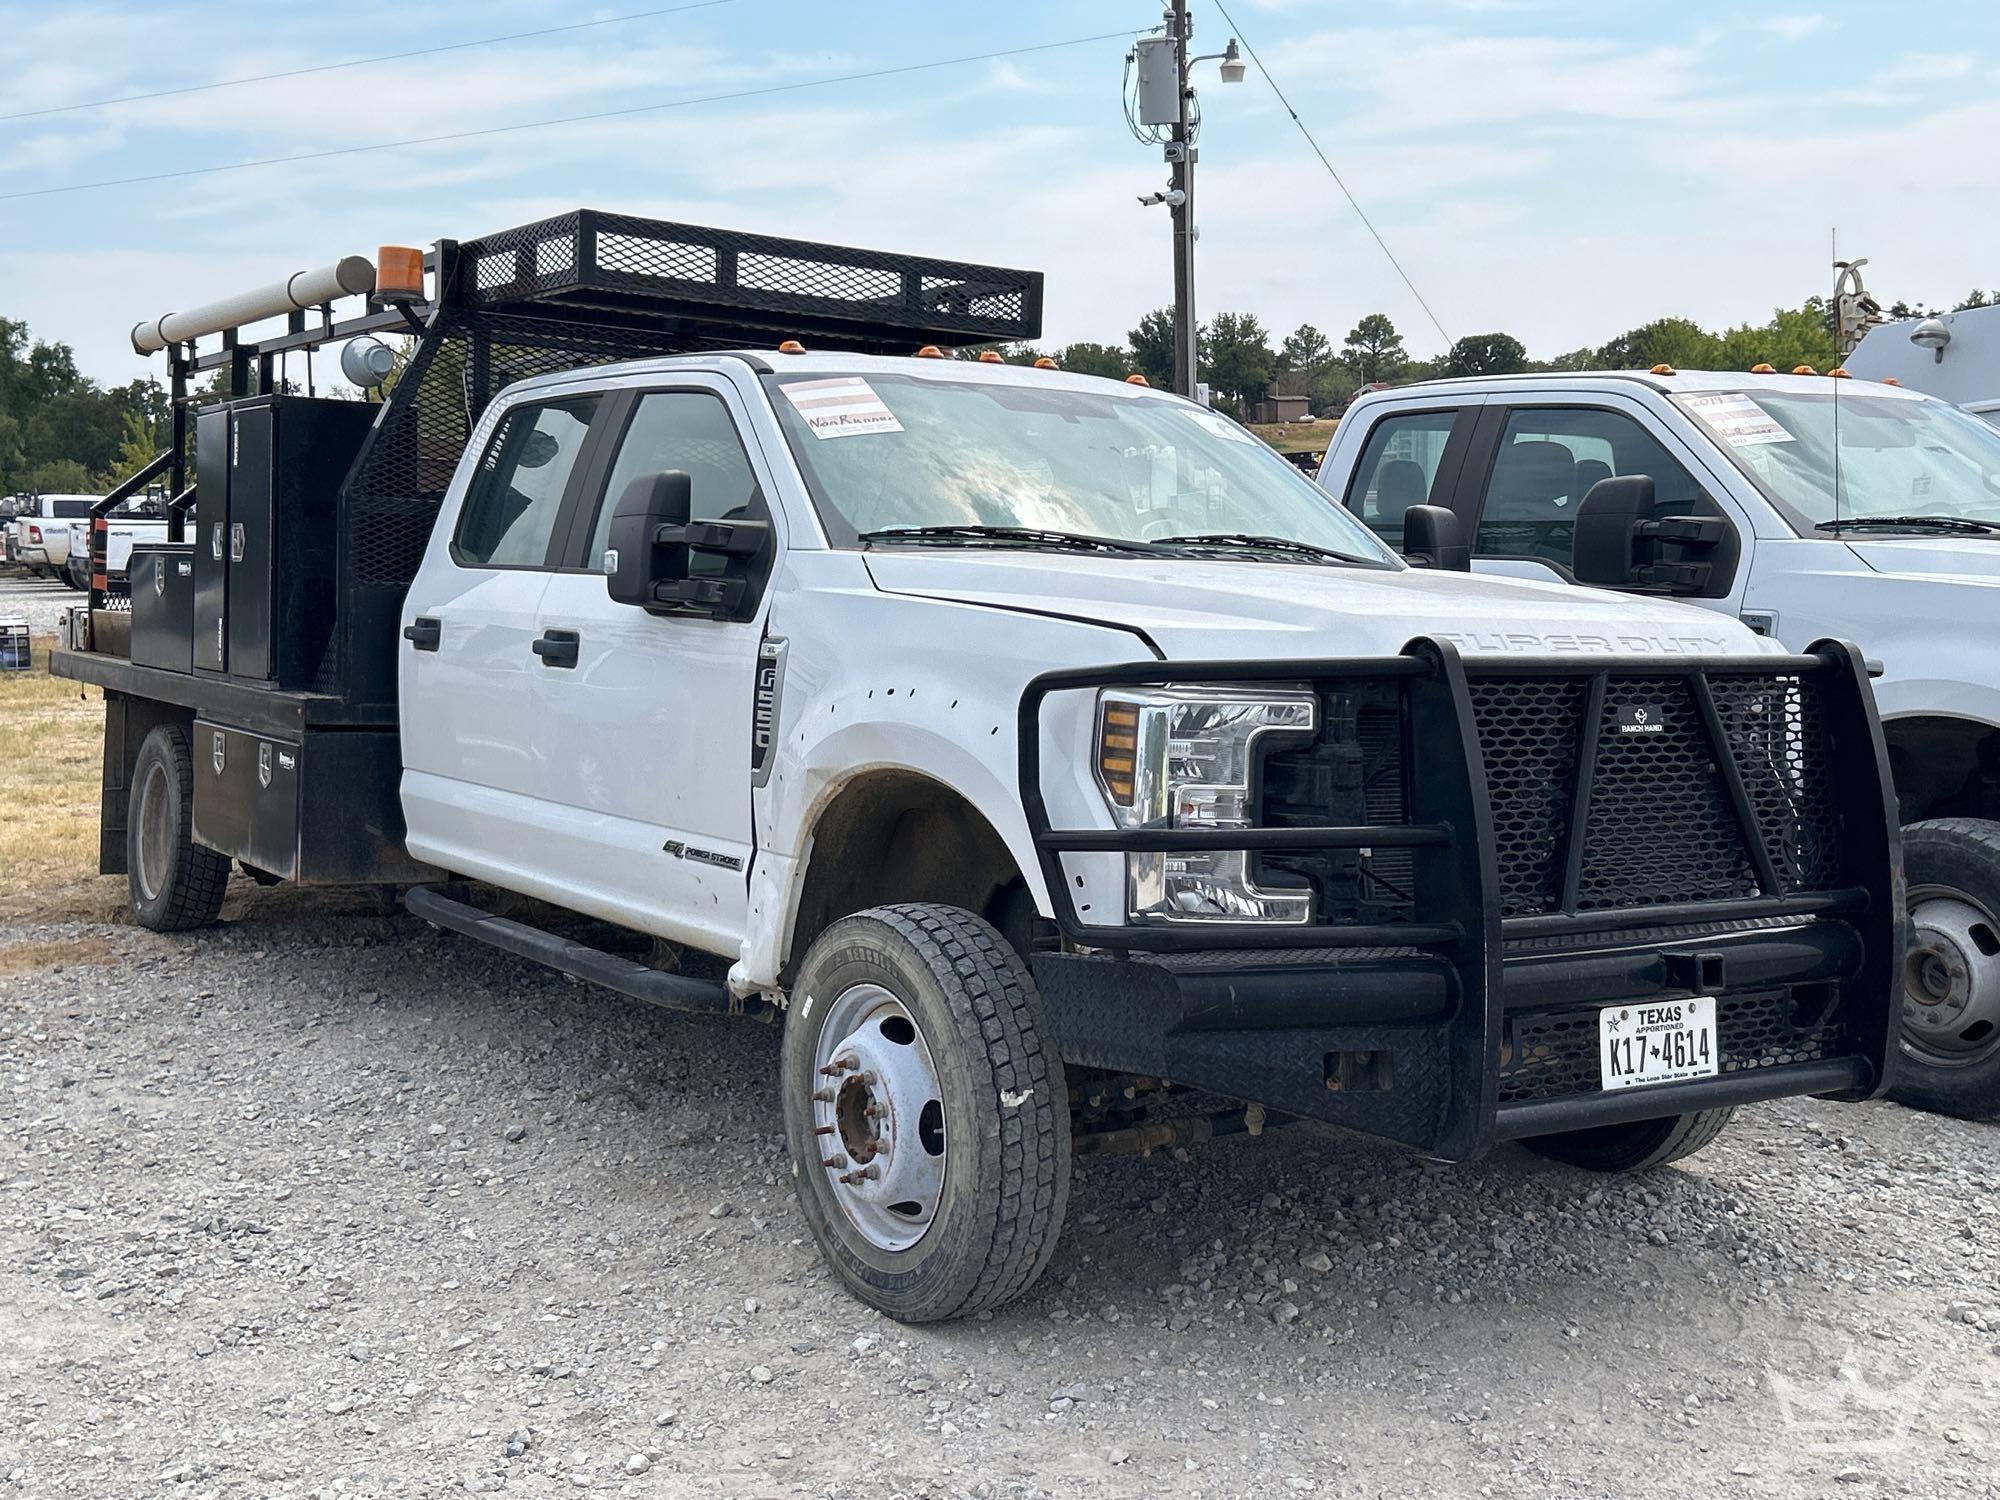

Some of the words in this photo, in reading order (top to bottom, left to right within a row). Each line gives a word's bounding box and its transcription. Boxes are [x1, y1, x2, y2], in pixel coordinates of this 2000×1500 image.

[1617, 636, 1727, 654] DUTY
[1621, 725, 1644, 733] RANCH
[1644, 724, 1663, 732] HAND
[711, 852, 742, 867] STROKE
[1638, 1006, 1682, 1025] TEXAS
[1635, 1022, 1684, 1034] APPORTIONED
